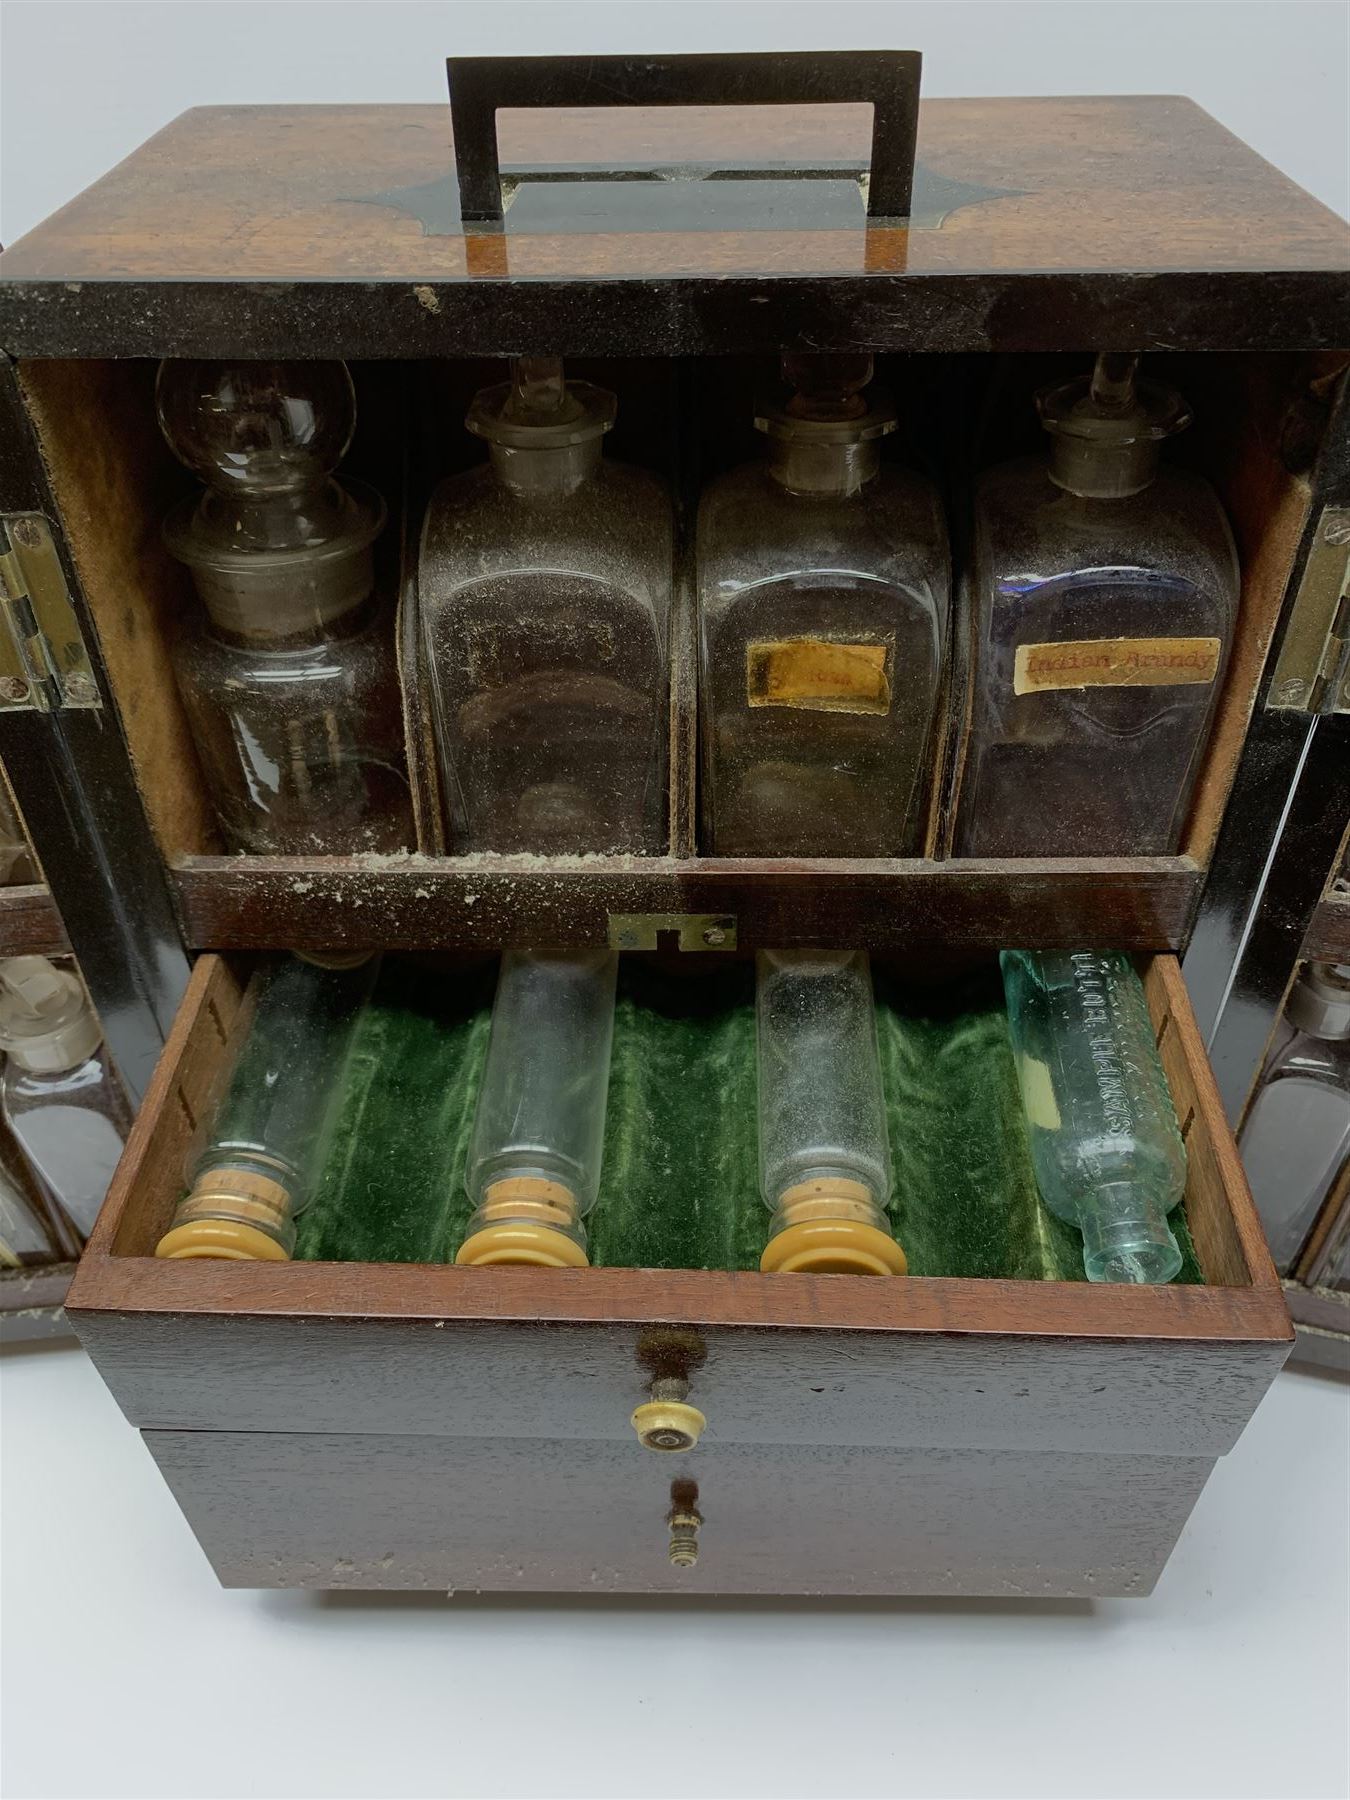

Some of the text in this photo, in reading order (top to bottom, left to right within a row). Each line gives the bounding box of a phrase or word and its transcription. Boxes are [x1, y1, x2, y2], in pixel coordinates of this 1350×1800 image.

[1027, 654, 1111, 673] Indian
[1069, 949, 1135, 1138] SAMPLE BOTTL
